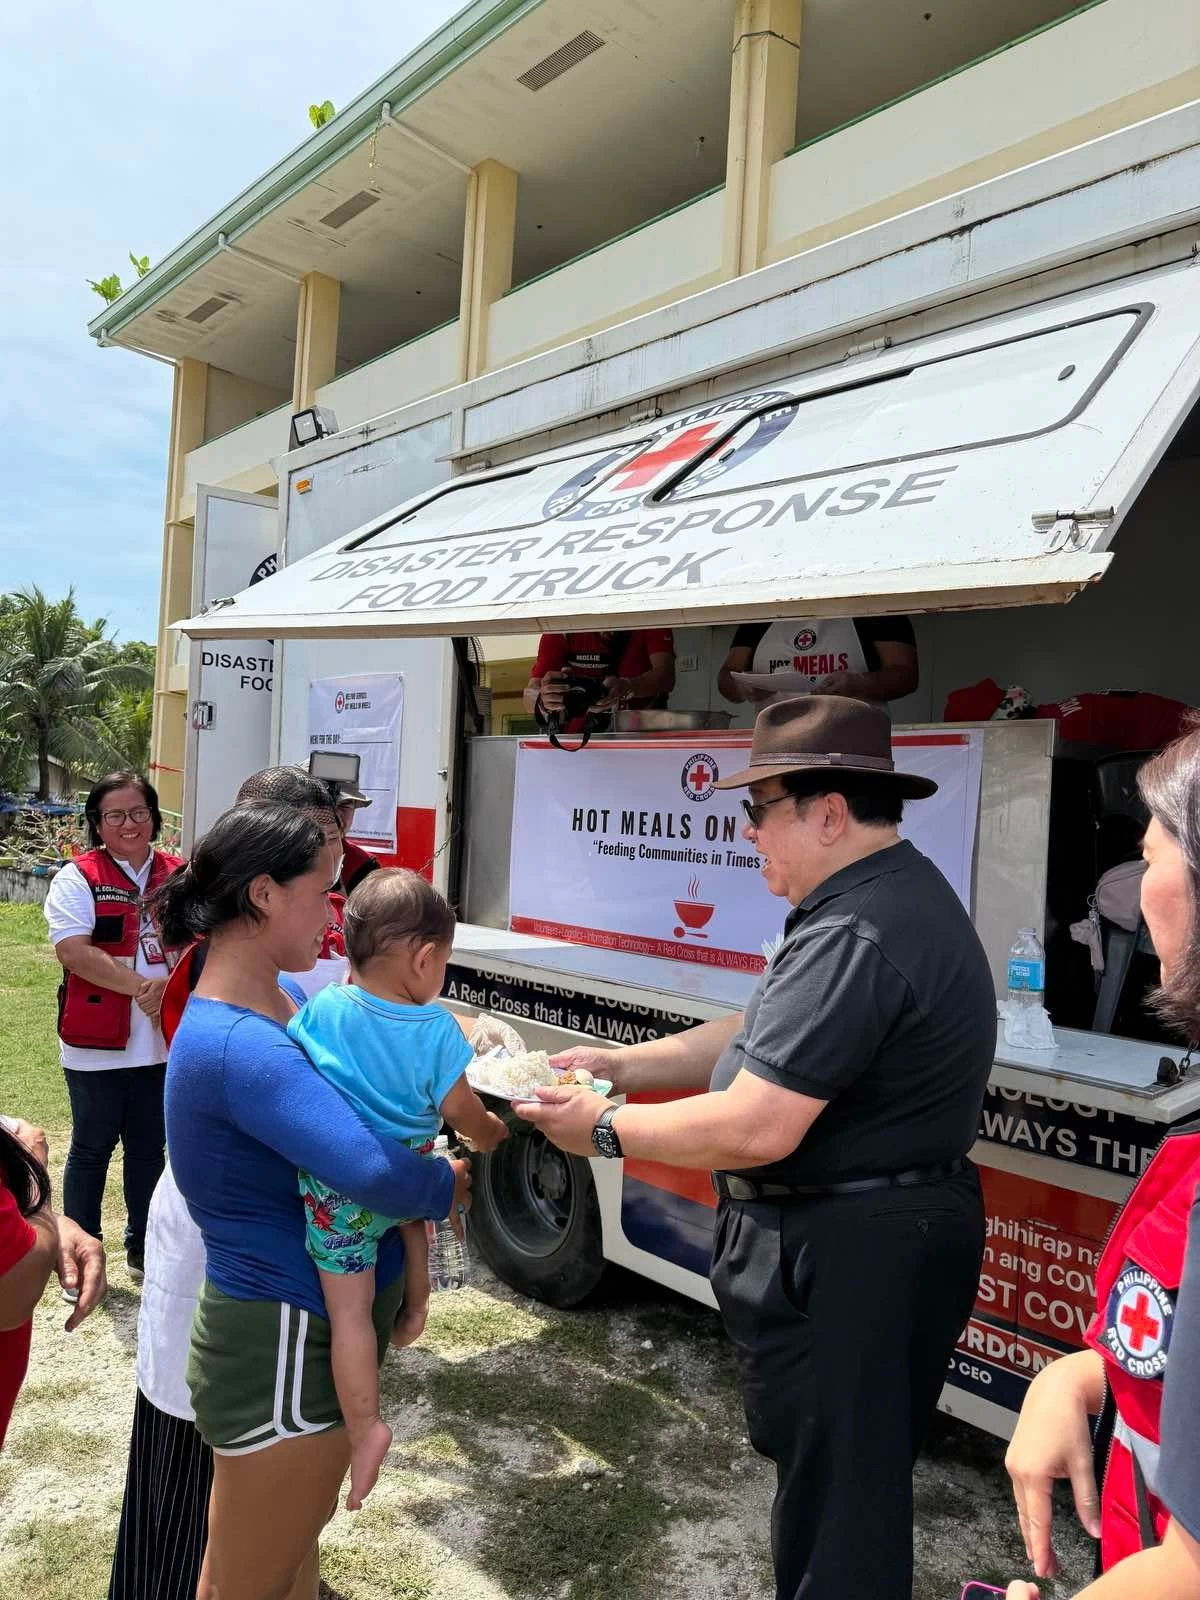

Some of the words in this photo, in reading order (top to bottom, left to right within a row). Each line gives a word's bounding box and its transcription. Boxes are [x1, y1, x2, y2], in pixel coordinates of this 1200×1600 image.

[584, 464, 728, 519] CRSS
[309, 537, 543, 582] DISASTER
[537, 465, 960, 560] RESPONSE
[337, 576, 488, 611] FOOD
[491, 546, 734, 602] TRUCK
[792, 652, 849, 676] MEALS
[571, 808, 611, 834] HOT
[620, 810, 692, 840] MEALS
[704, 815, 737, 843] ON
[638, 843, 708, 865] Communities
[711, 851, 722, 866] in
[725, 850, 761, 869] Times
[97, 894, 128, 903] MANAGER
[716, 951, 748, 969] ALWAYS
[749, 956, 767, 971] FIRS
[448, 980, 458, 998] A
[460, 983, 486, 1005] Red
[489, 990, 530, 1016] Cross
[534, 1001, 563, 1026] that
[567, 1008, 581, 1030] is
[584, 1013, 658, 1043] ALWAYS
[978, 1110, 1078, 1158] WAYS
[999, 1252, 1042, 1283] ang
[1024, 1290, 1098, 1337] COV
[1116, 1270, 1173, 1317] PHILIPPINE
[957, 1325, 1055, 1373] RDON
[1107, 1327, 1126, 1361] RED
[1127, 1349, 1168, 1376] CROSS
[958, 1362, 993, 1385] CEO
